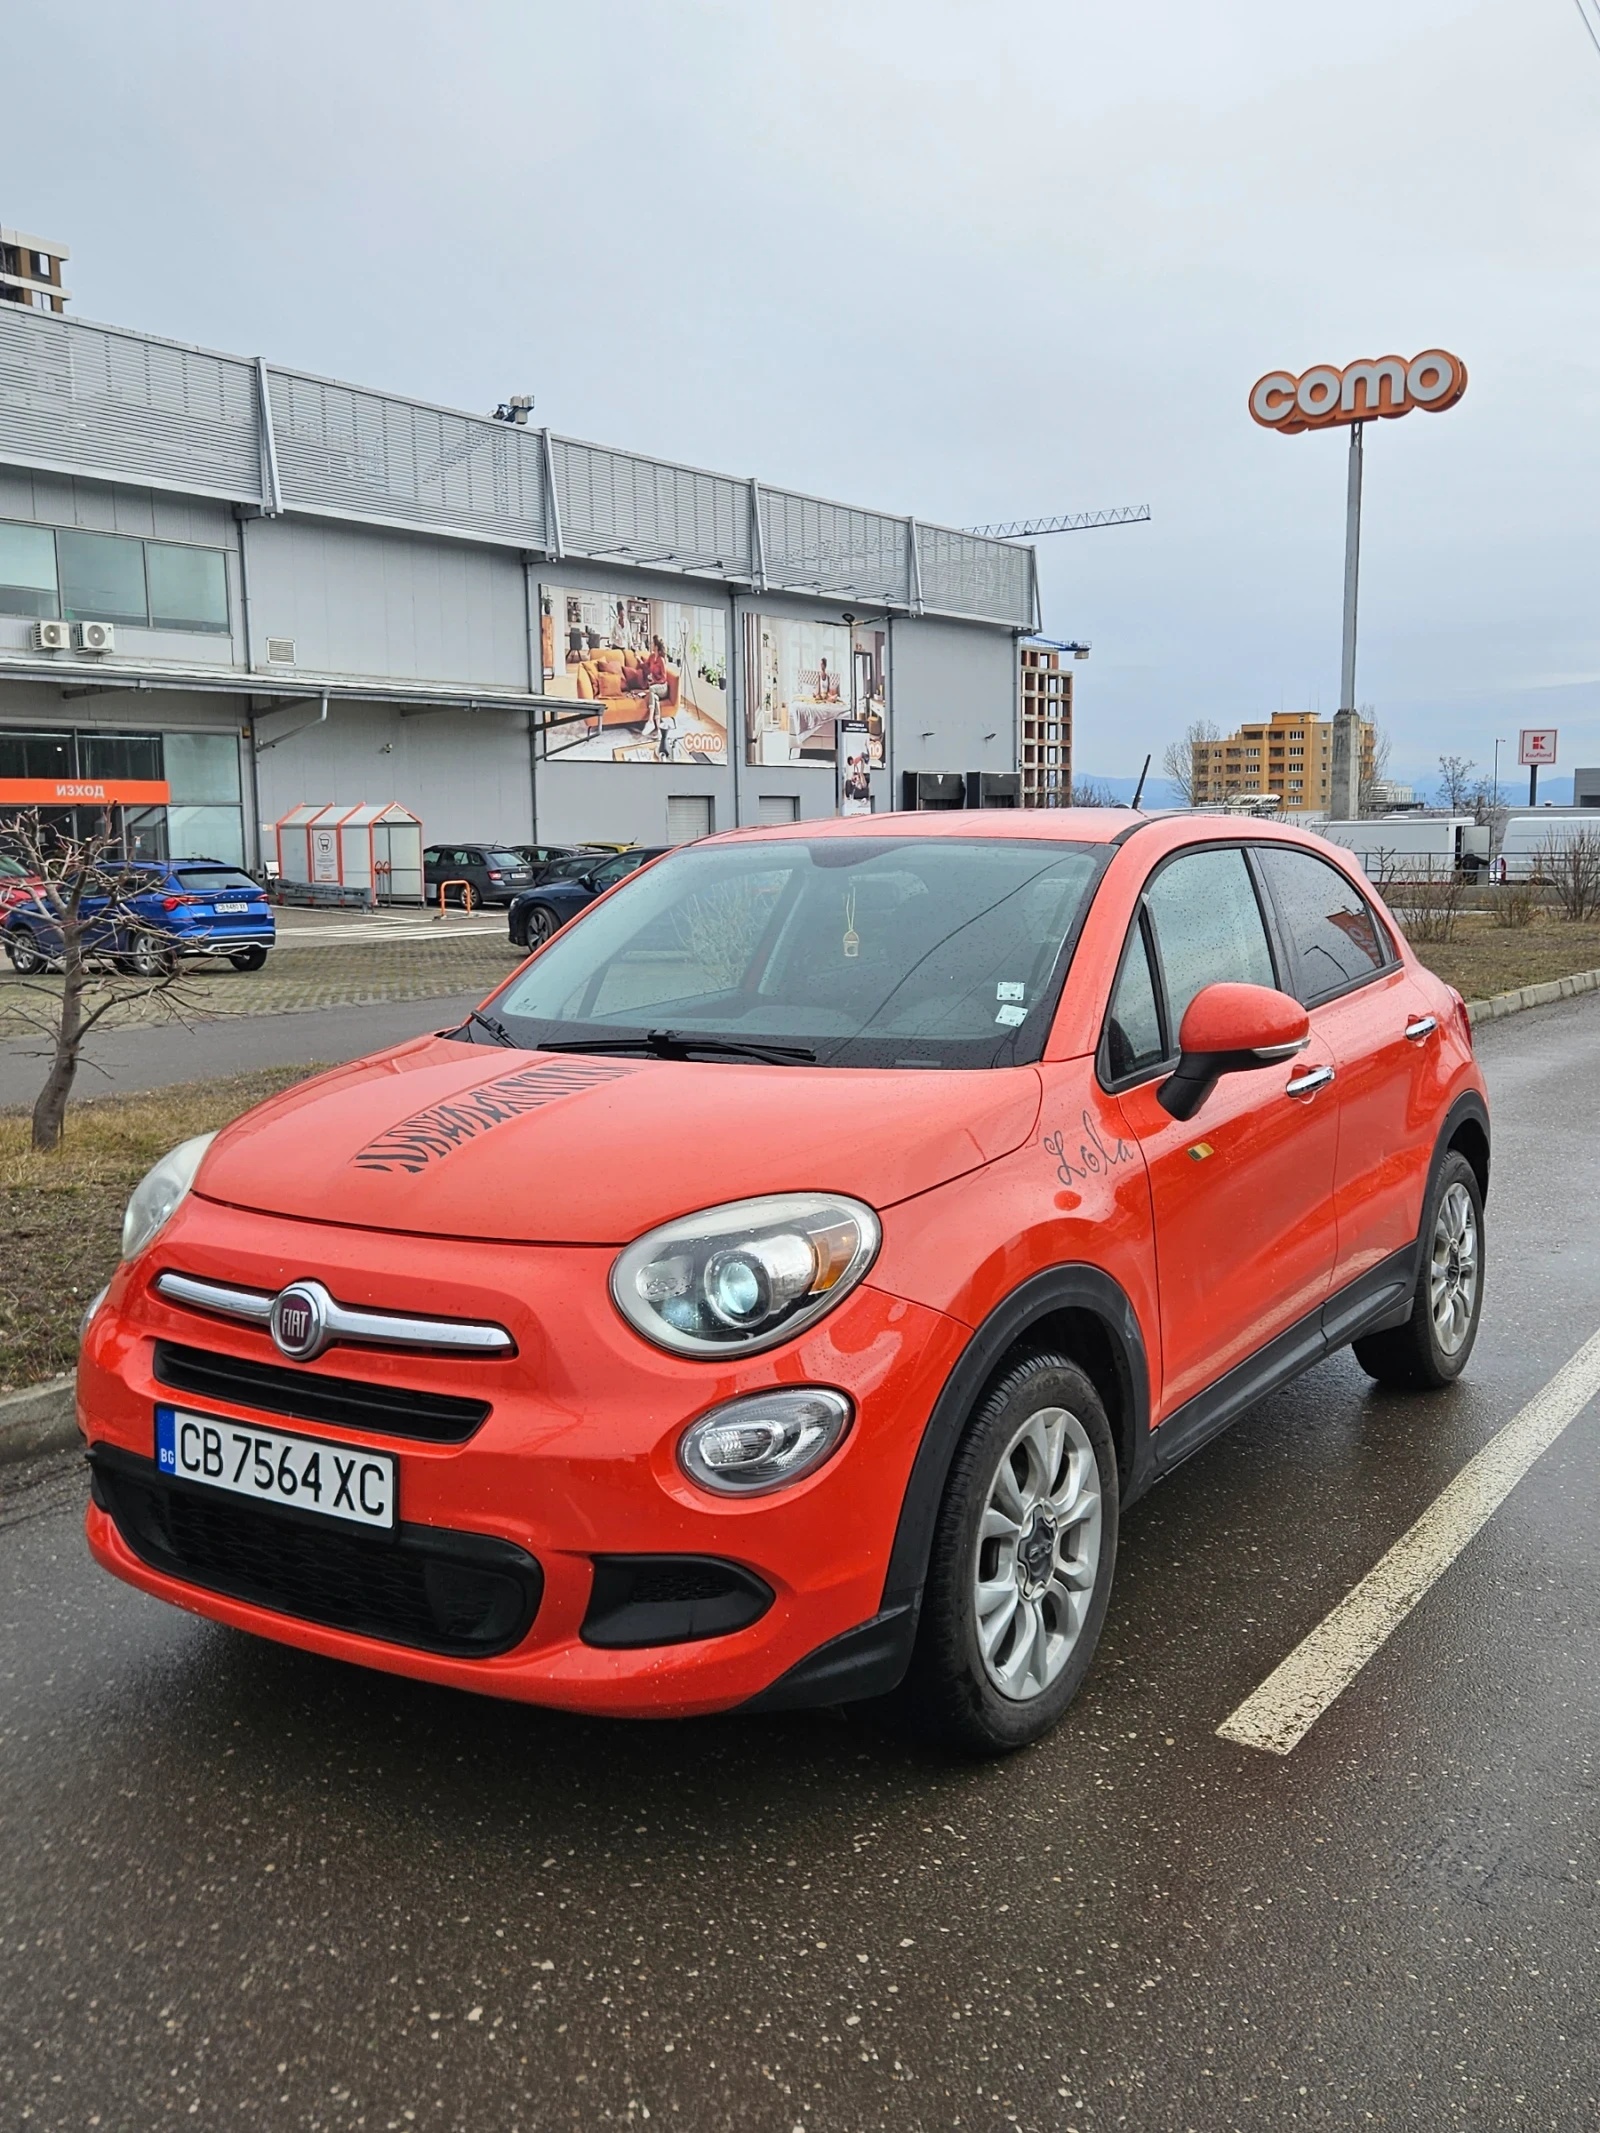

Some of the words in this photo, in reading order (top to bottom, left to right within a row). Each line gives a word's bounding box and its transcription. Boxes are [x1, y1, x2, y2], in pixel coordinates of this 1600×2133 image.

[1253, 354, 1453, 421] como
[684, 733, 722, 751] como
[56, 784, 105, 799] ИЗХОД
[1043, 1110, 1134, 1186] Lola
[281, 1308, 309, 1338] FIAT
[160, 1448, 174, 1465] BG
[180, 1422, 224, 1478] CB
[232, 1433, 322, 1503] 7564
[333, 1455, 385, 1516] XC
